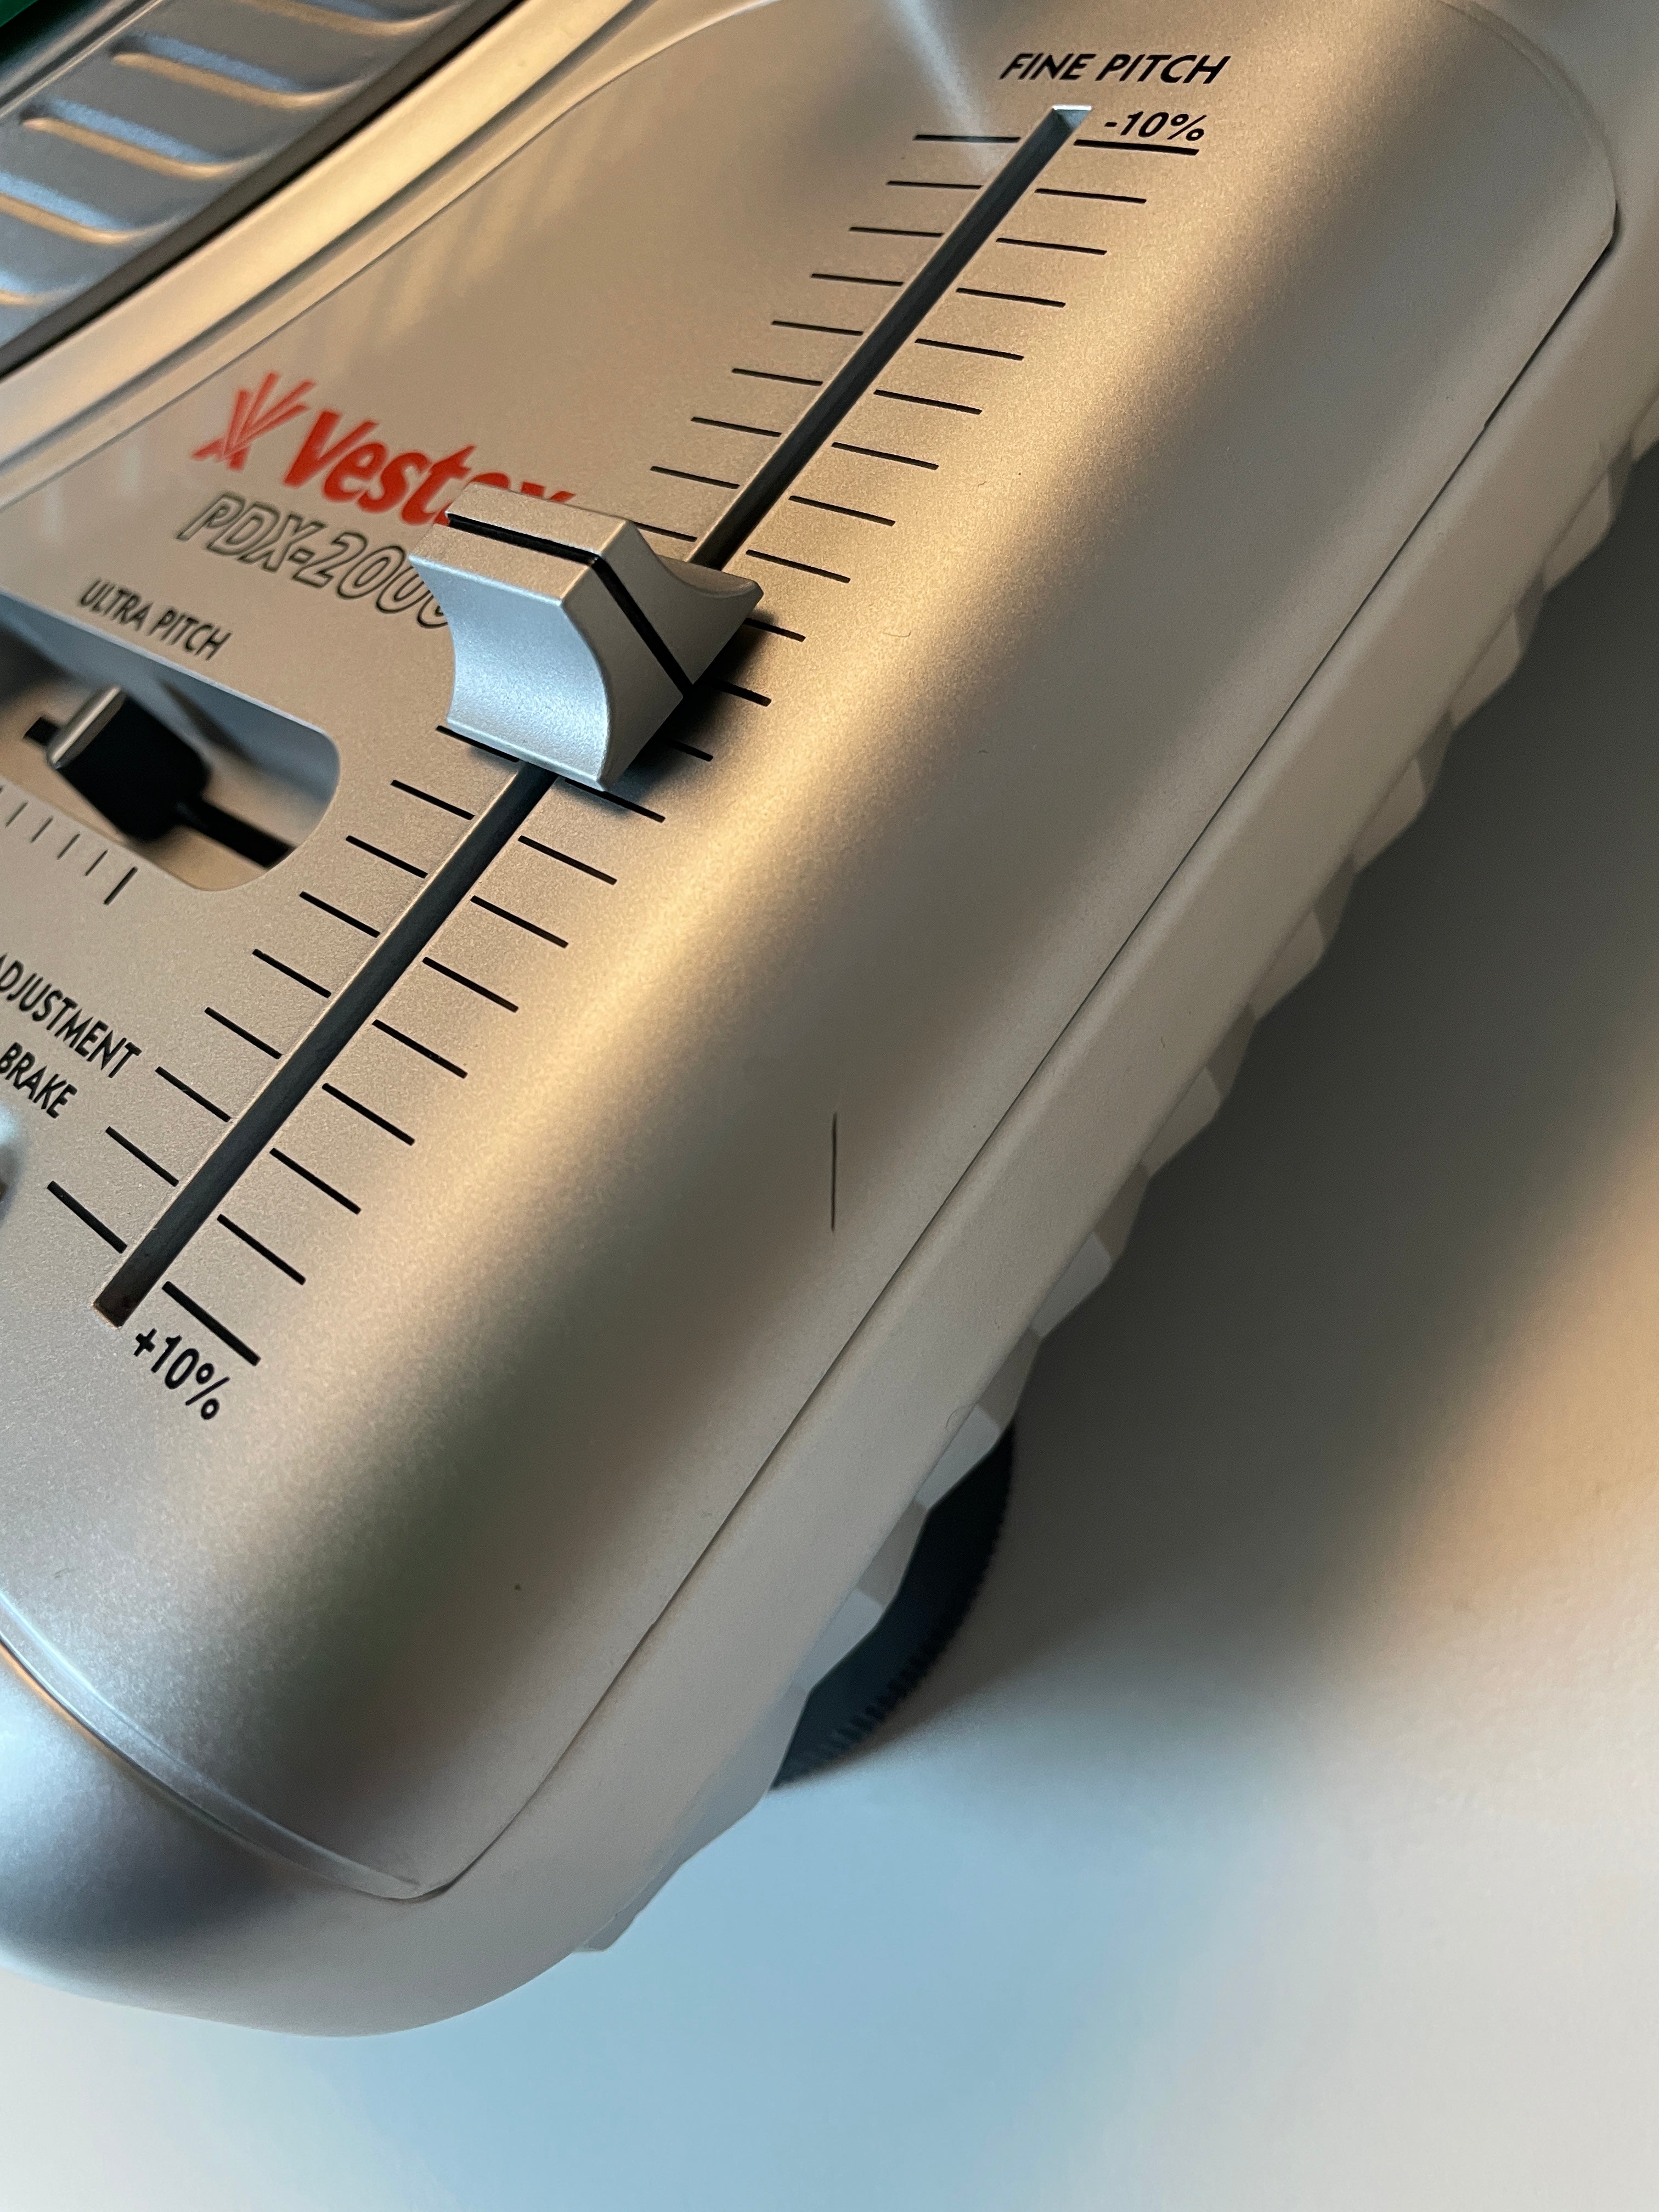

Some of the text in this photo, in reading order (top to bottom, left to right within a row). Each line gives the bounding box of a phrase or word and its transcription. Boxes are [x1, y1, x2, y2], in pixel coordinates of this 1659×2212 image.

[998, 53, 1231, 84] FINE PITCH
[1104, 111, 1207, 142] -10%
[284, 408, 577, 527] Vest
[80, 578, 233, 661] ULTRA PITCH
[0, 1042, 78, 1119] BRAKE
[133, 1328, 230, 1420] +10%
